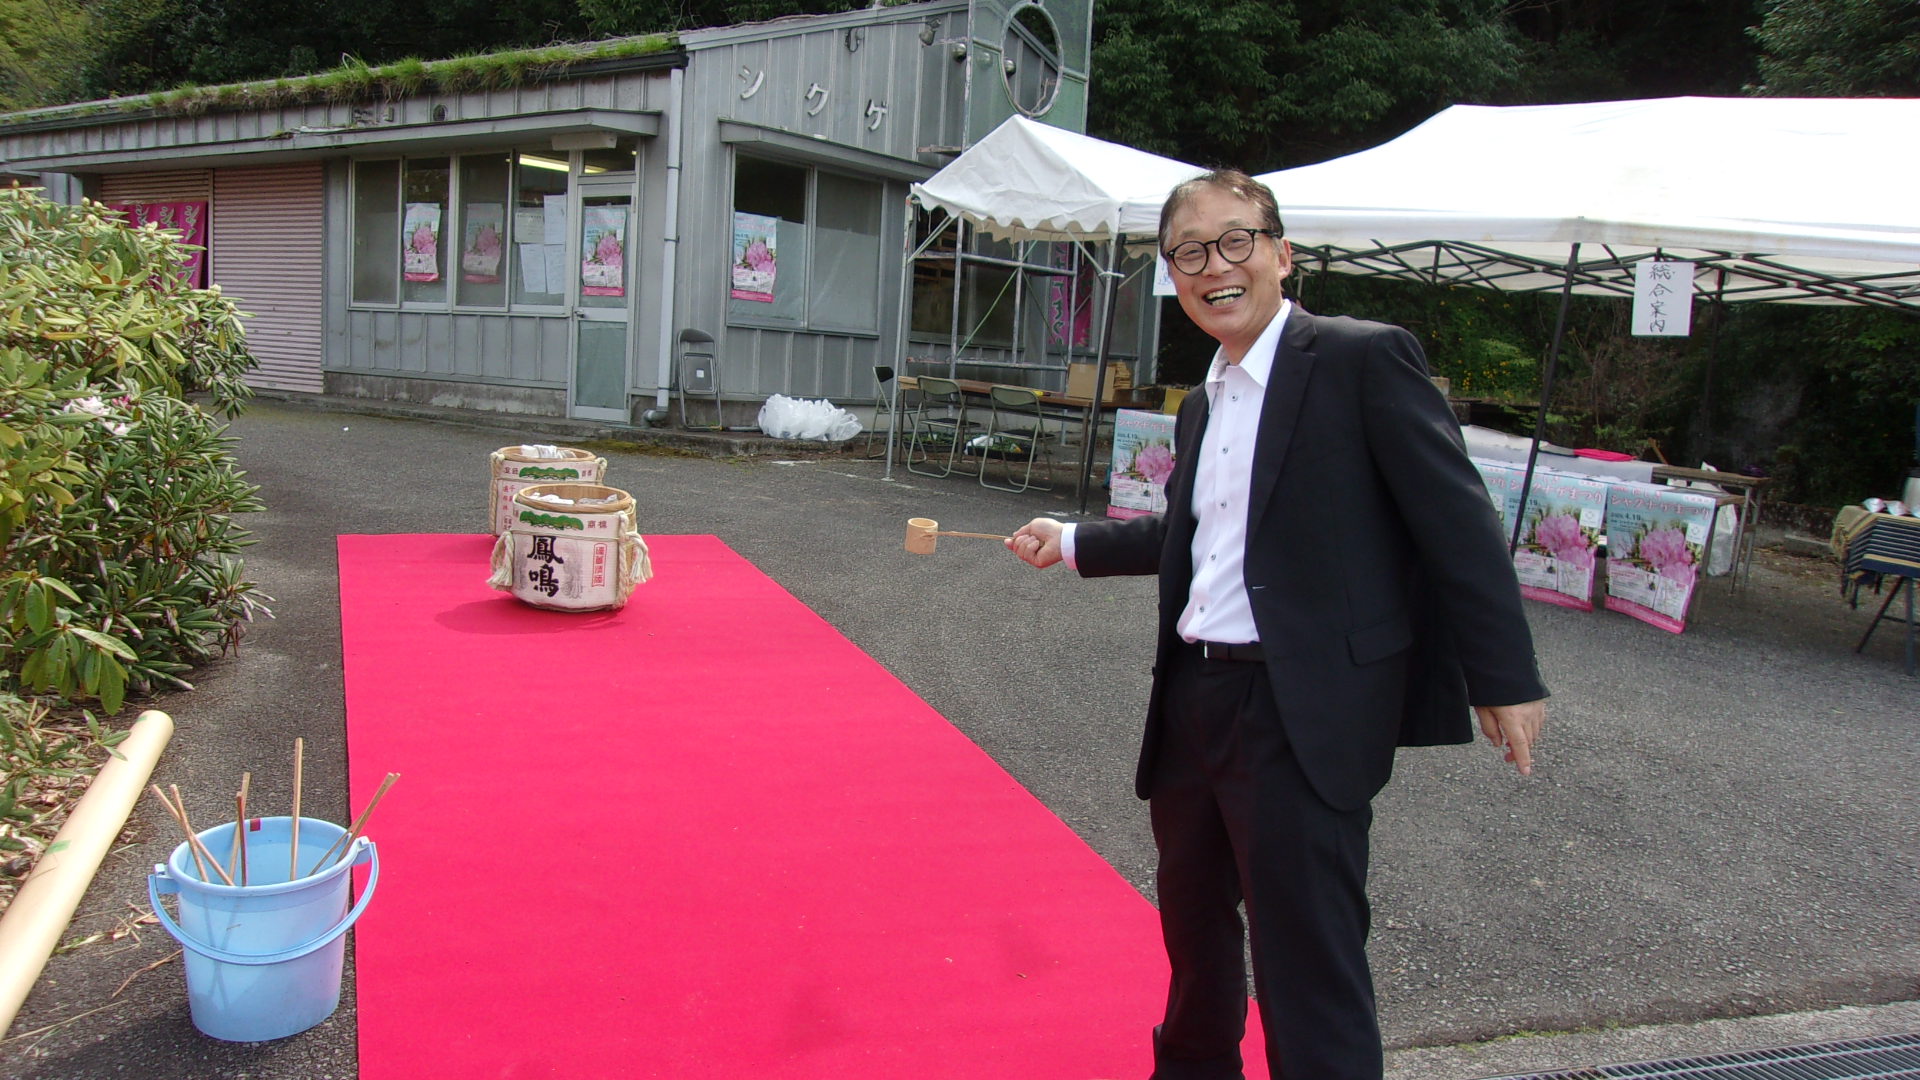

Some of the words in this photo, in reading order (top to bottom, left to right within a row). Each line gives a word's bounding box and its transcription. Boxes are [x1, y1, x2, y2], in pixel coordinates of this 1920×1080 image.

[1648, 263, 1675, 333] 総合案内
[1510, 479, 1604, 505] シクナゲまつり
[527, 535, 564, 597] 鳳鳴
